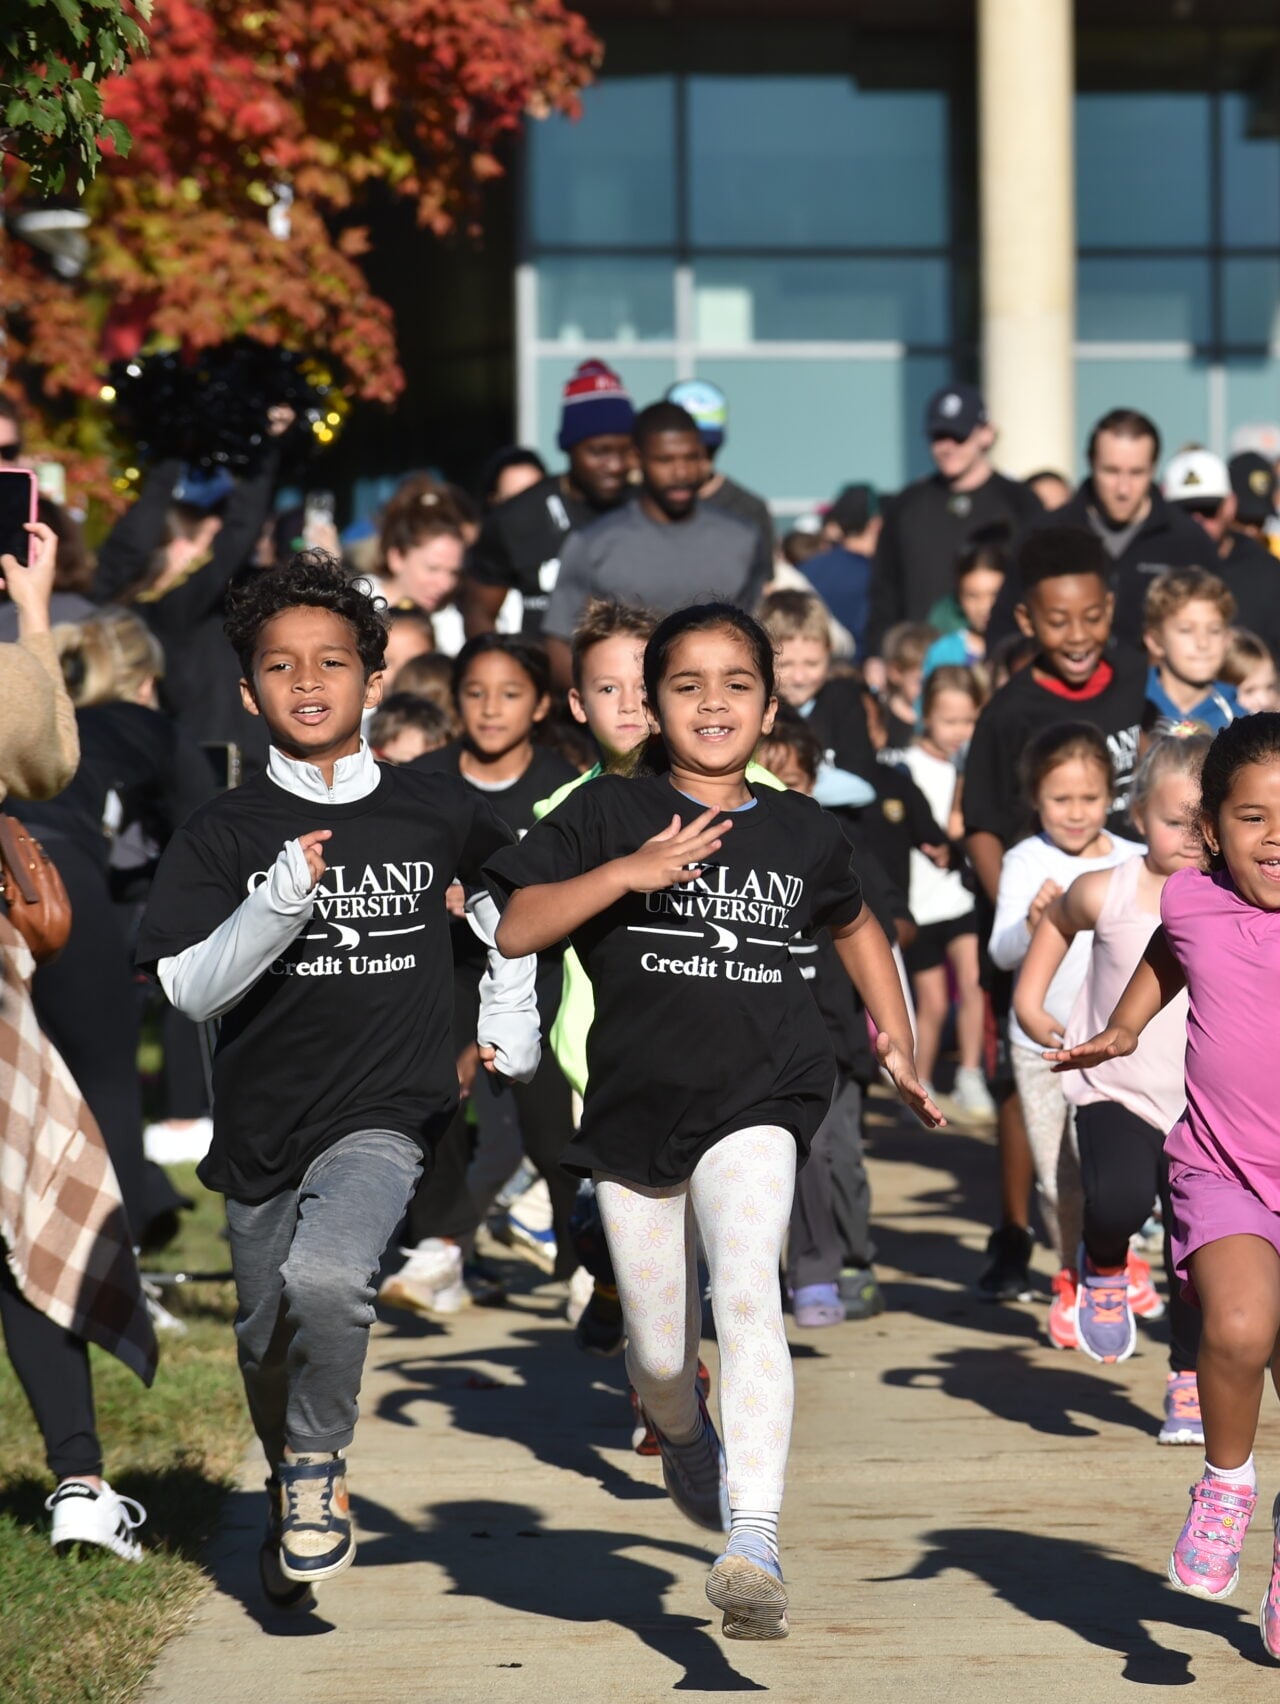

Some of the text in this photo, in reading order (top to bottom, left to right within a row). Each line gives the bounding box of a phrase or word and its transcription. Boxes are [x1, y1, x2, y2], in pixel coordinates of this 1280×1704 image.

[247, 861, 434, 898] OLAND
[672, 862, 804, 907] KLAND
[270, 953, 416, 976] Credit Union
[641, 952, 782, 983] Credit Union
